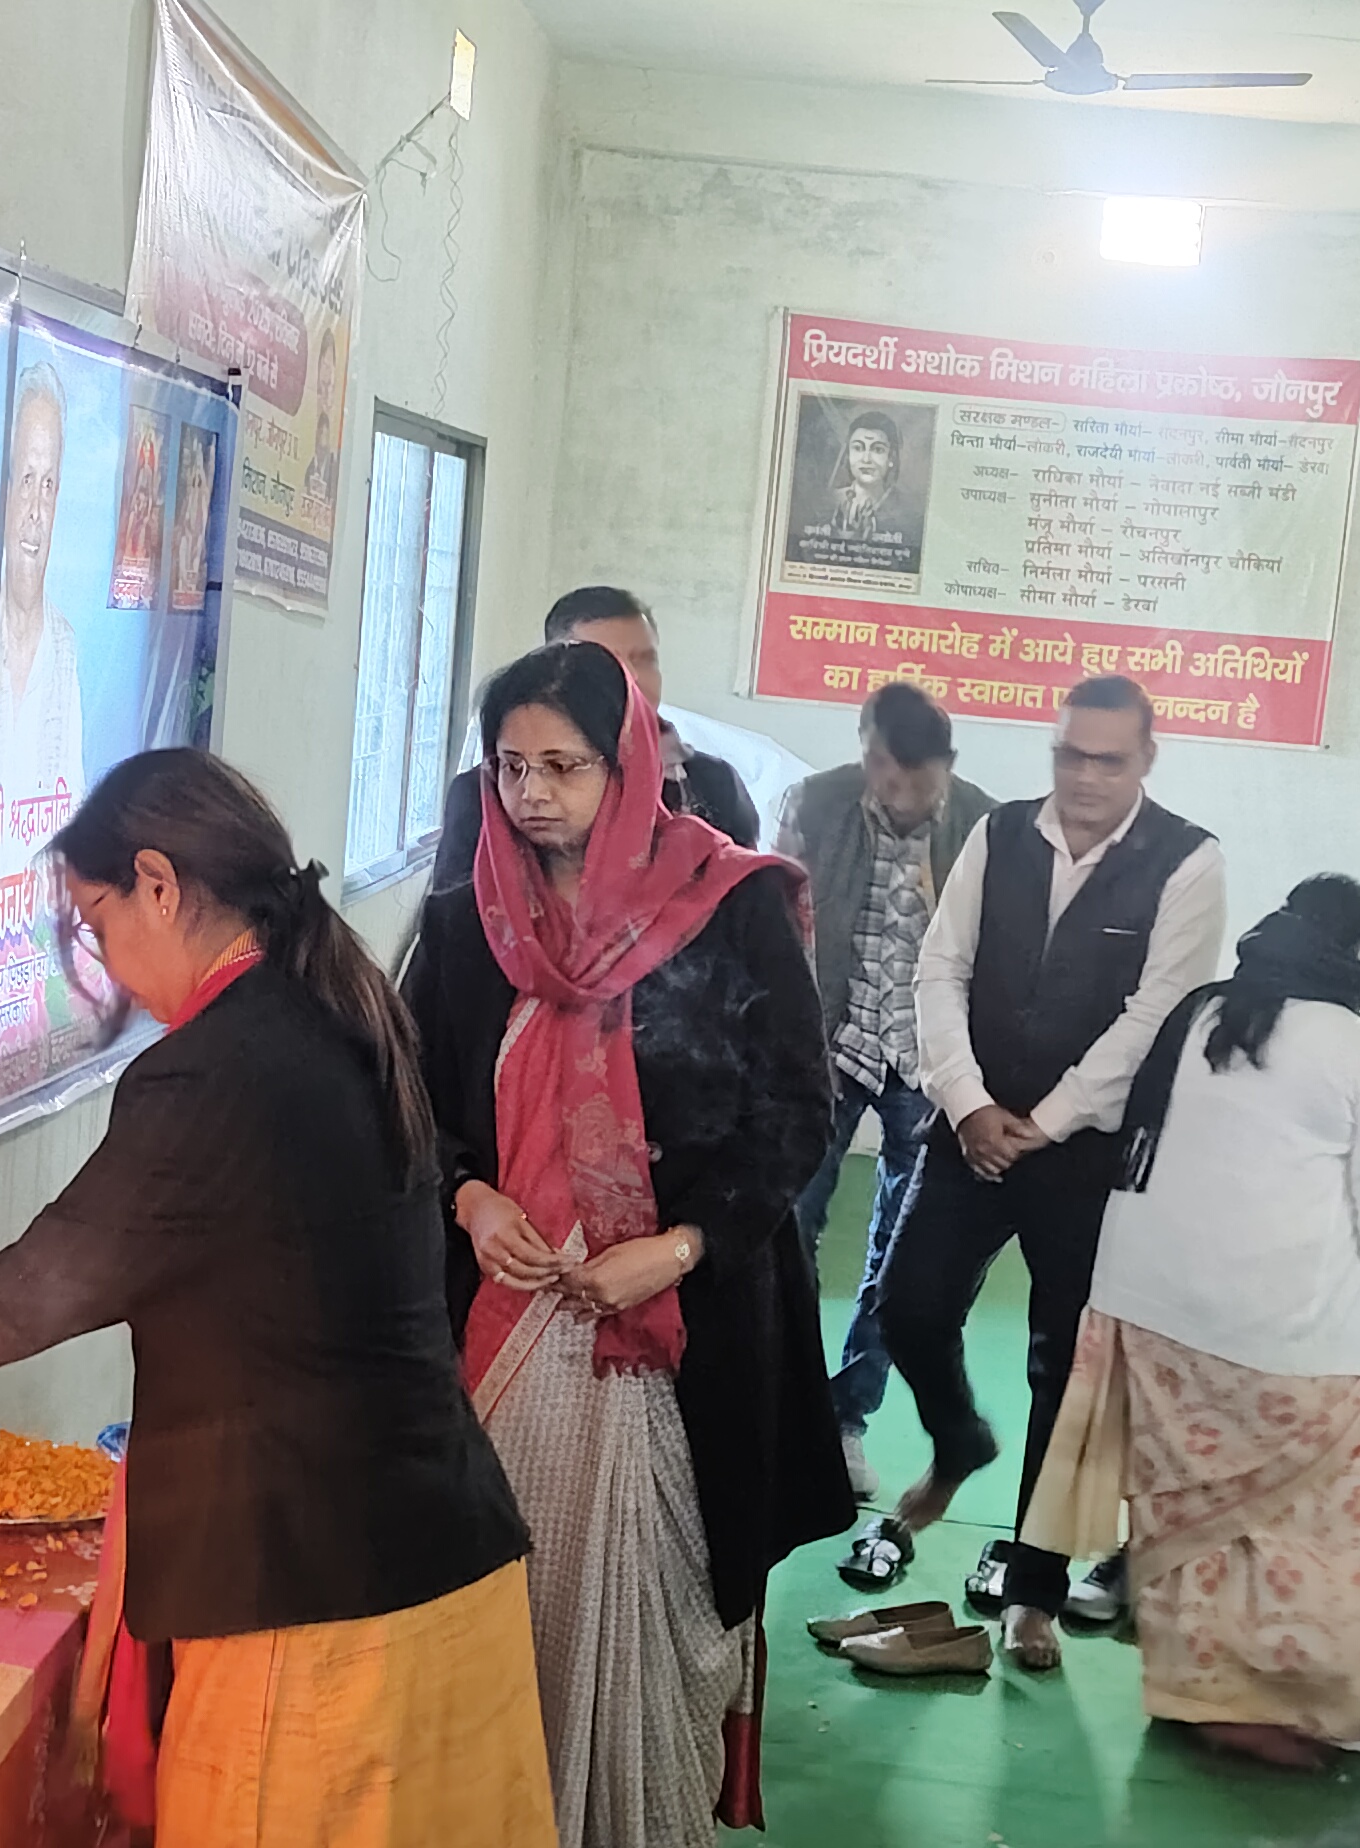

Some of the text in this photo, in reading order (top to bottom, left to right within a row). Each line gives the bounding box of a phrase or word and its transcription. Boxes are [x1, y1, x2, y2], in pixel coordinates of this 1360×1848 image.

[803, 329, 898, 371] प्रियदर्शी
[901, 344, 983, 378] अशोक
[989, 348, 1063, 386] मिशन
[1068, 356, 1151, 395] महिला
[1252, 369, 1342, 418] जौनपुर
[1031, 464, 1083, 486] राधिका
[1029, 488, 1077, 512] सुनीता
[1022, 558, 1071, 581] निर्मला
[1020, 584, 1056, 605] सीमा
[790, 615, 1309, 684] सम्मान समारोह में आये हुए सभी अतिथियों
[823, 664, 862, 690] का
[957, 677, 1046, 709] स्वागत
[1237, 693, 1260, 730] है
